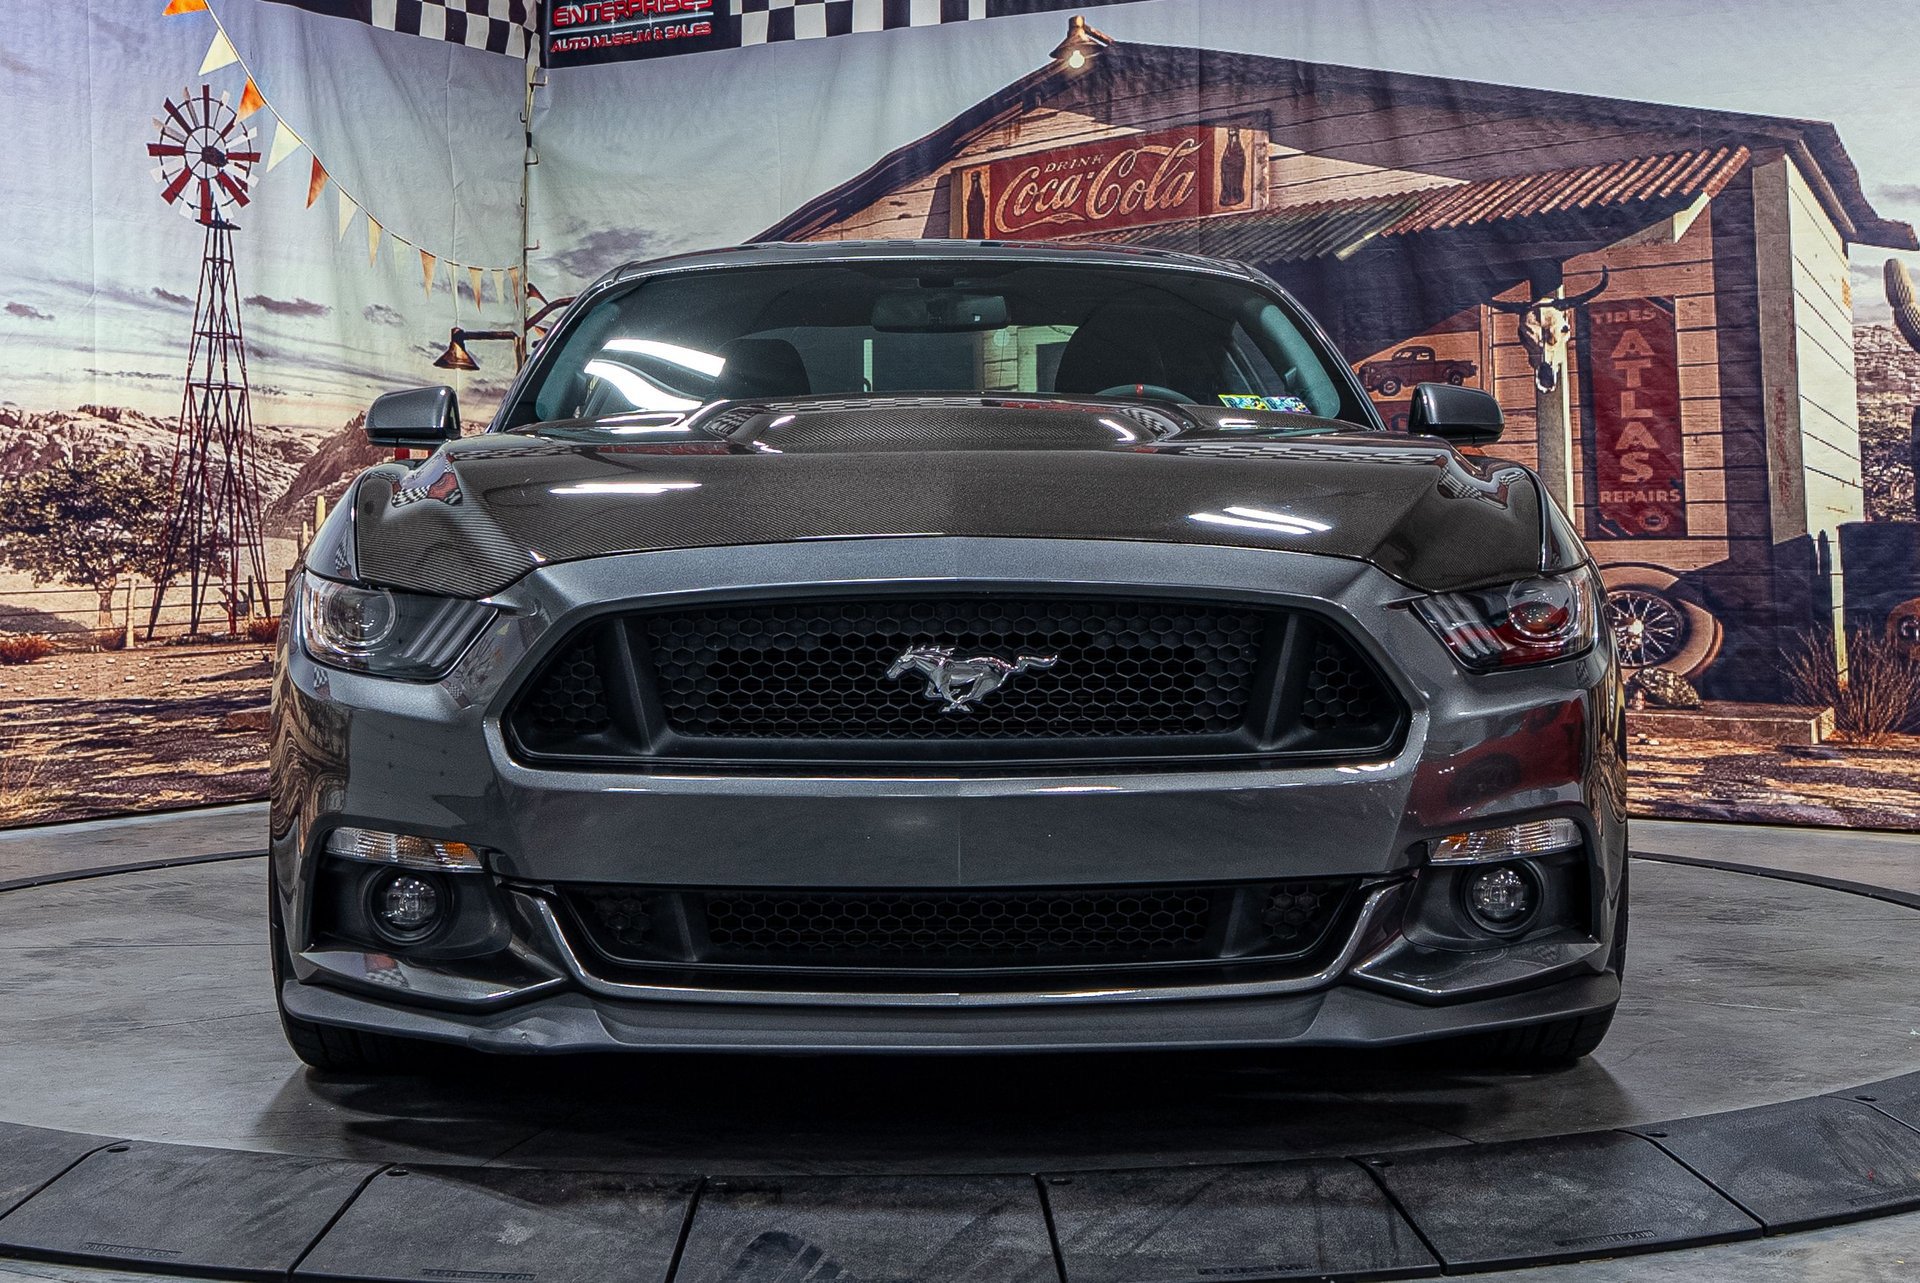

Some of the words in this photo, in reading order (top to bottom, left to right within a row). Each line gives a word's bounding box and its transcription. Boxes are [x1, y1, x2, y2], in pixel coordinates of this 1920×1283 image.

[551, 36, 591, 52] AUTO
[592, 28, 652, 47] MUSEUM
[653, 26, 664, 40] &
[664, 21, 712, 39] SALES
[1044, 153, 1105, 173] DRINK
[994, 138, 1204, 233] Coca-Cola
[1590, 308, 1657, 325] TIRES
[1610, 328, 1661, 484] ATLAS
[1600, 489, 1681, 504] REPAIRS
